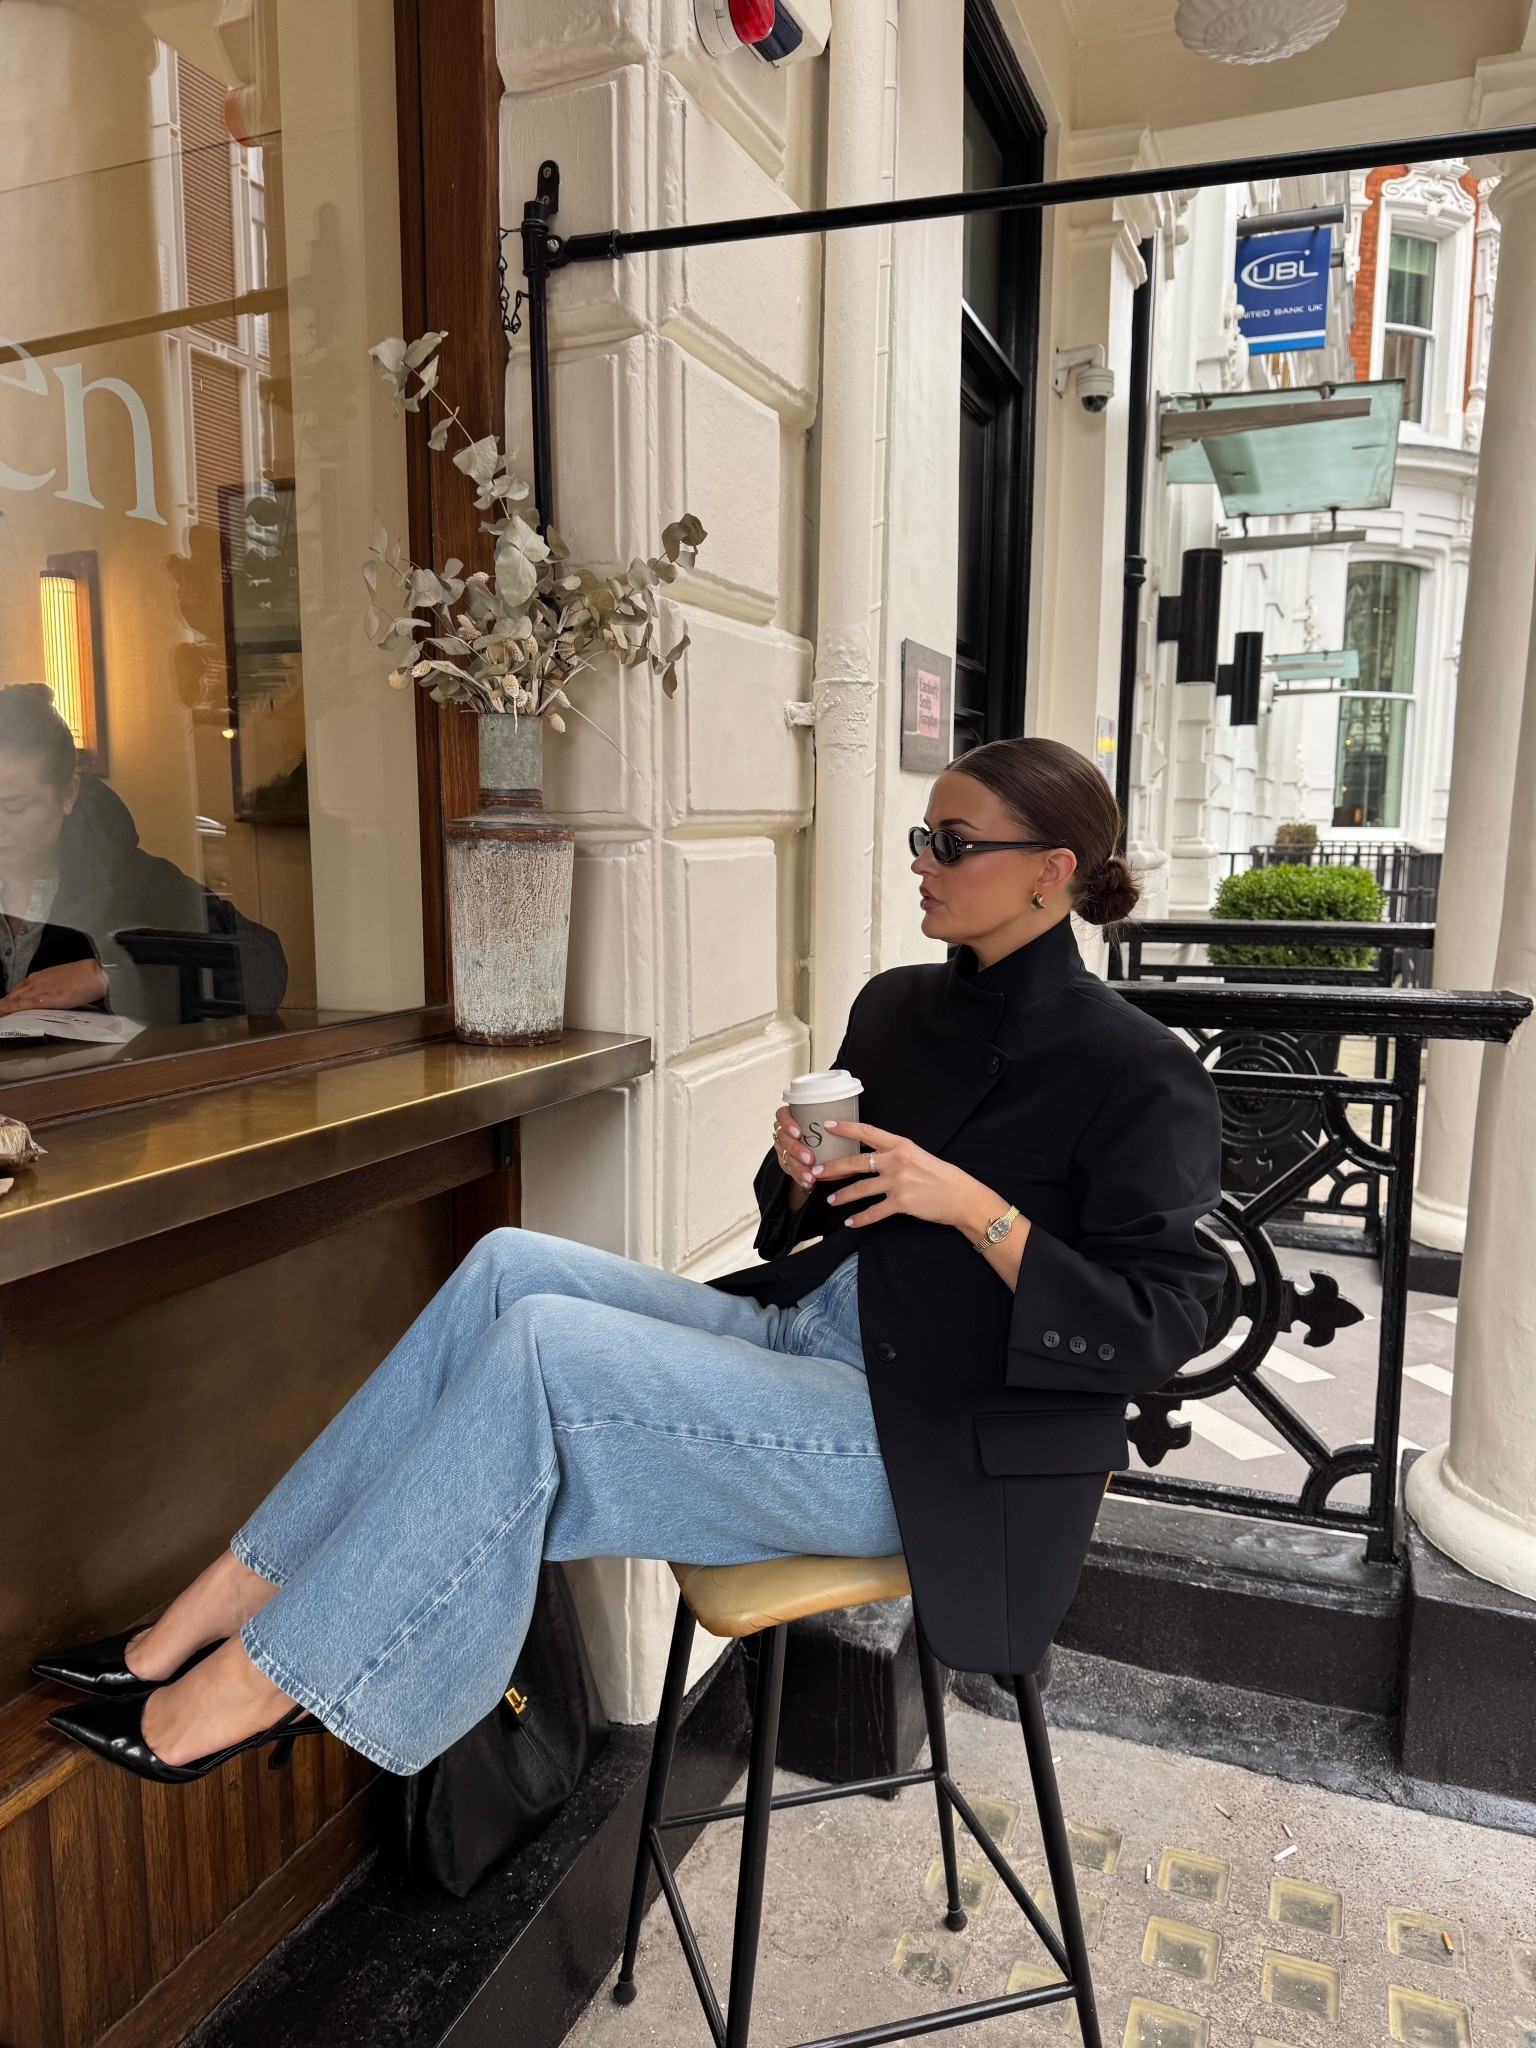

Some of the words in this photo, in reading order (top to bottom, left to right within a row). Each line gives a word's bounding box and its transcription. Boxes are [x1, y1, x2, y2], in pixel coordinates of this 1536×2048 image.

[1252, 259, 1319, 283] UBL
[1243, 309, 1271, 319] NITED
[1274, 306, 1304, 316] BANK
[1307, 303, 1323, 312] UK
[803, 1122, 823, 1148] S
